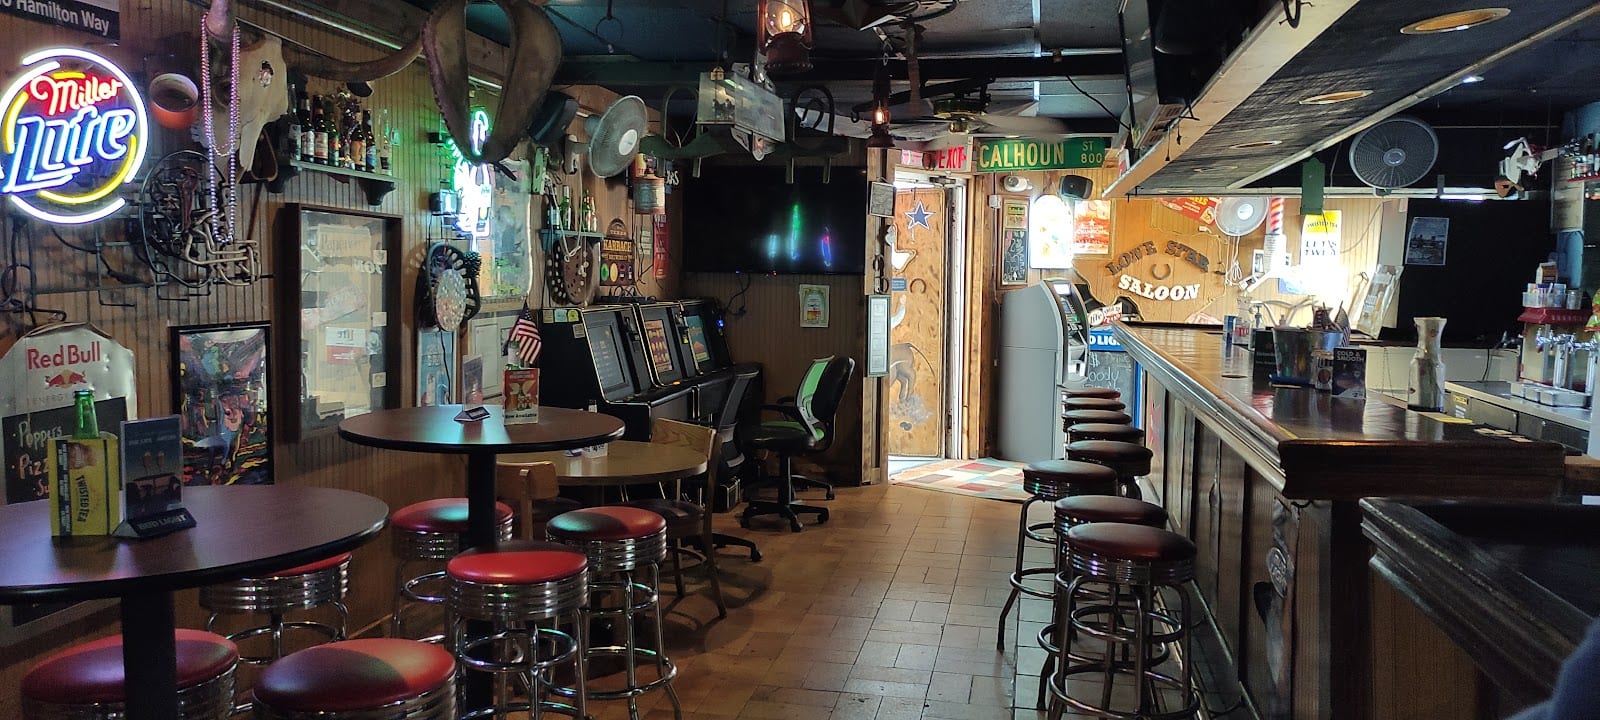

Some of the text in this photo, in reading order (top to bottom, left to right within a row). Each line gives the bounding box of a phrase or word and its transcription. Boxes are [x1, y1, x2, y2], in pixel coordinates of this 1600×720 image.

[16, 0, 110, 36] Hamilton Way
[29, 73, 123, 117] Miller
[2, 104, 137, 194] Lite
[978, 142, 1065, 168] CALHOUN
[1080, 152, 1102, 164] 800
[1081, 140, 1094, 151] ST
[603, 239, 632, 252] KARBACH
[1105, 240, 1158, 275] LONE
[1164, 240, 1210, 273] STAR
[1118, 273, 1201, 301] SALOON
[1097, 334, 1120, 346] LIG
[27, 341, 101, 370] Red Bull
[75, 474, 90, 523] TWISTED TEA
[159, 513, 187, 527] LIGHT
